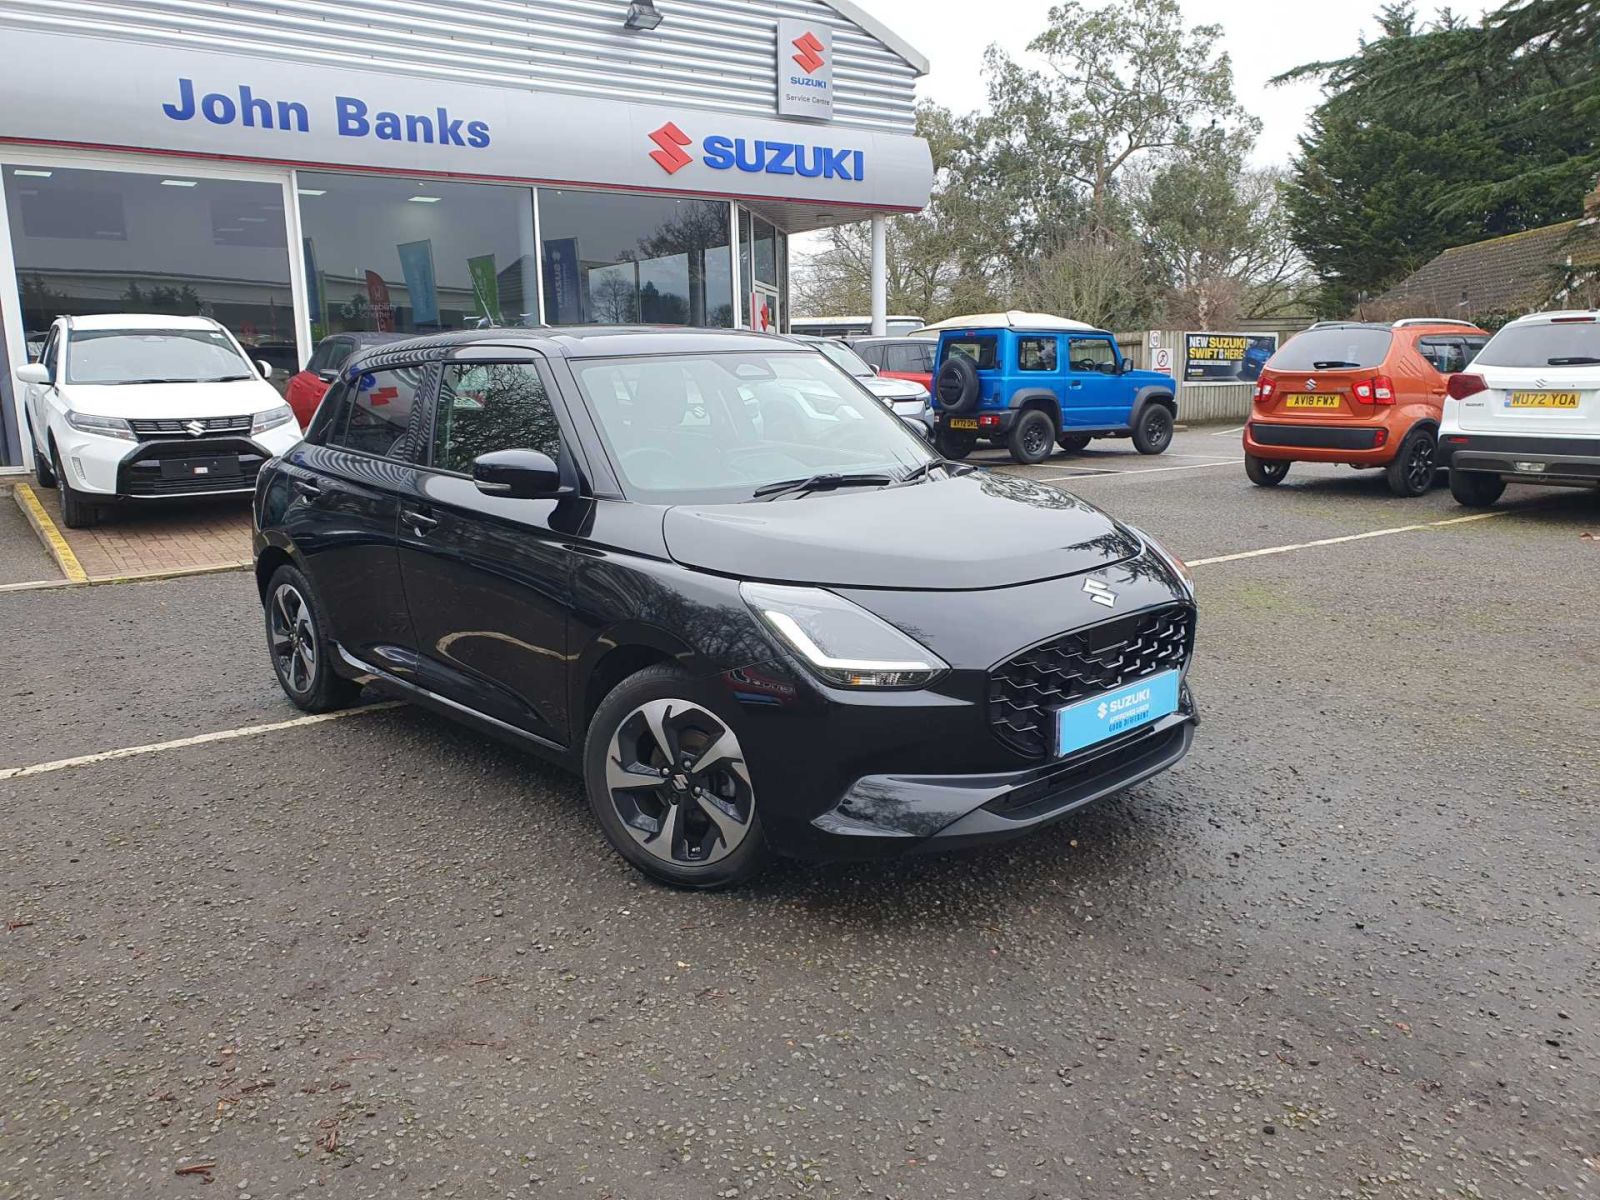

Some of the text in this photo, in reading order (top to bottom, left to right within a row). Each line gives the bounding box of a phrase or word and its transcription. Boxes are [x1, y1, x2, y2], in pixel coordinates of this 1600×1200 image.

[790, 76, 827, 89] SUZUKI
[786, 94, 830, 105] Service Centre
[162, 78, 490, 148] John Banks
[703, 135, 864, 181] SUZUKI
[1189, 336, 1246, 349] NEW SUZUKI
[1189, 348, 1218, 359] SWIFT
[1294, 395, 1336, 406] AV18 FWX
[1110, 688, 1150, 712] SUZUKI
